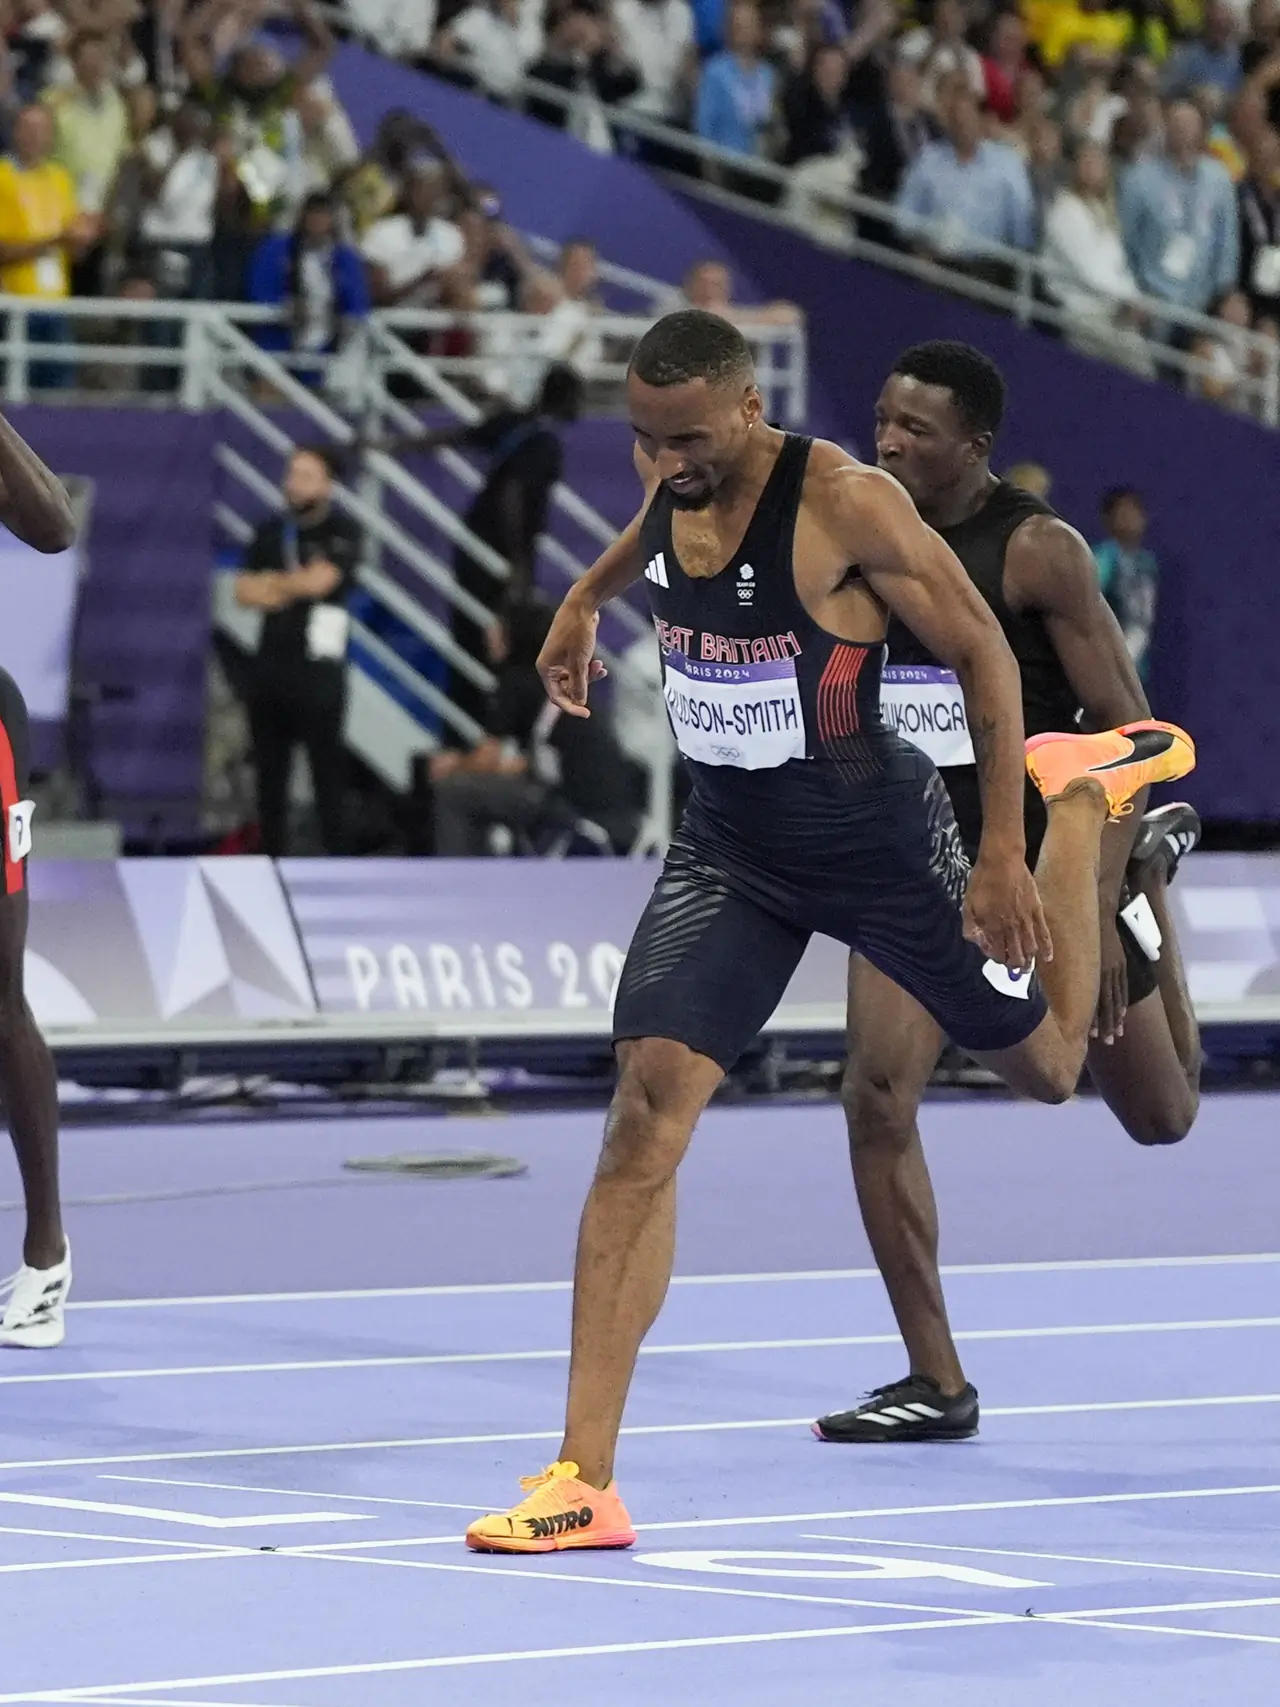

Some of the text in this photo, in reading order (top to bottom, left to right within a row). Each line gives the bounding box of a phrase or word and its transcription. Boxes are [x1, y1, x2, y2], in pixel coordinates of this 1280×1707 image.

[652, 612, 802, 663] EAT BRITAIN
[715, 668, 750, 680] 2024
[900, 670, 928, 680] 2024
[346, 942, 626, 1008] PARIS 20
[527, 1506, 593, 1540] NITRO
